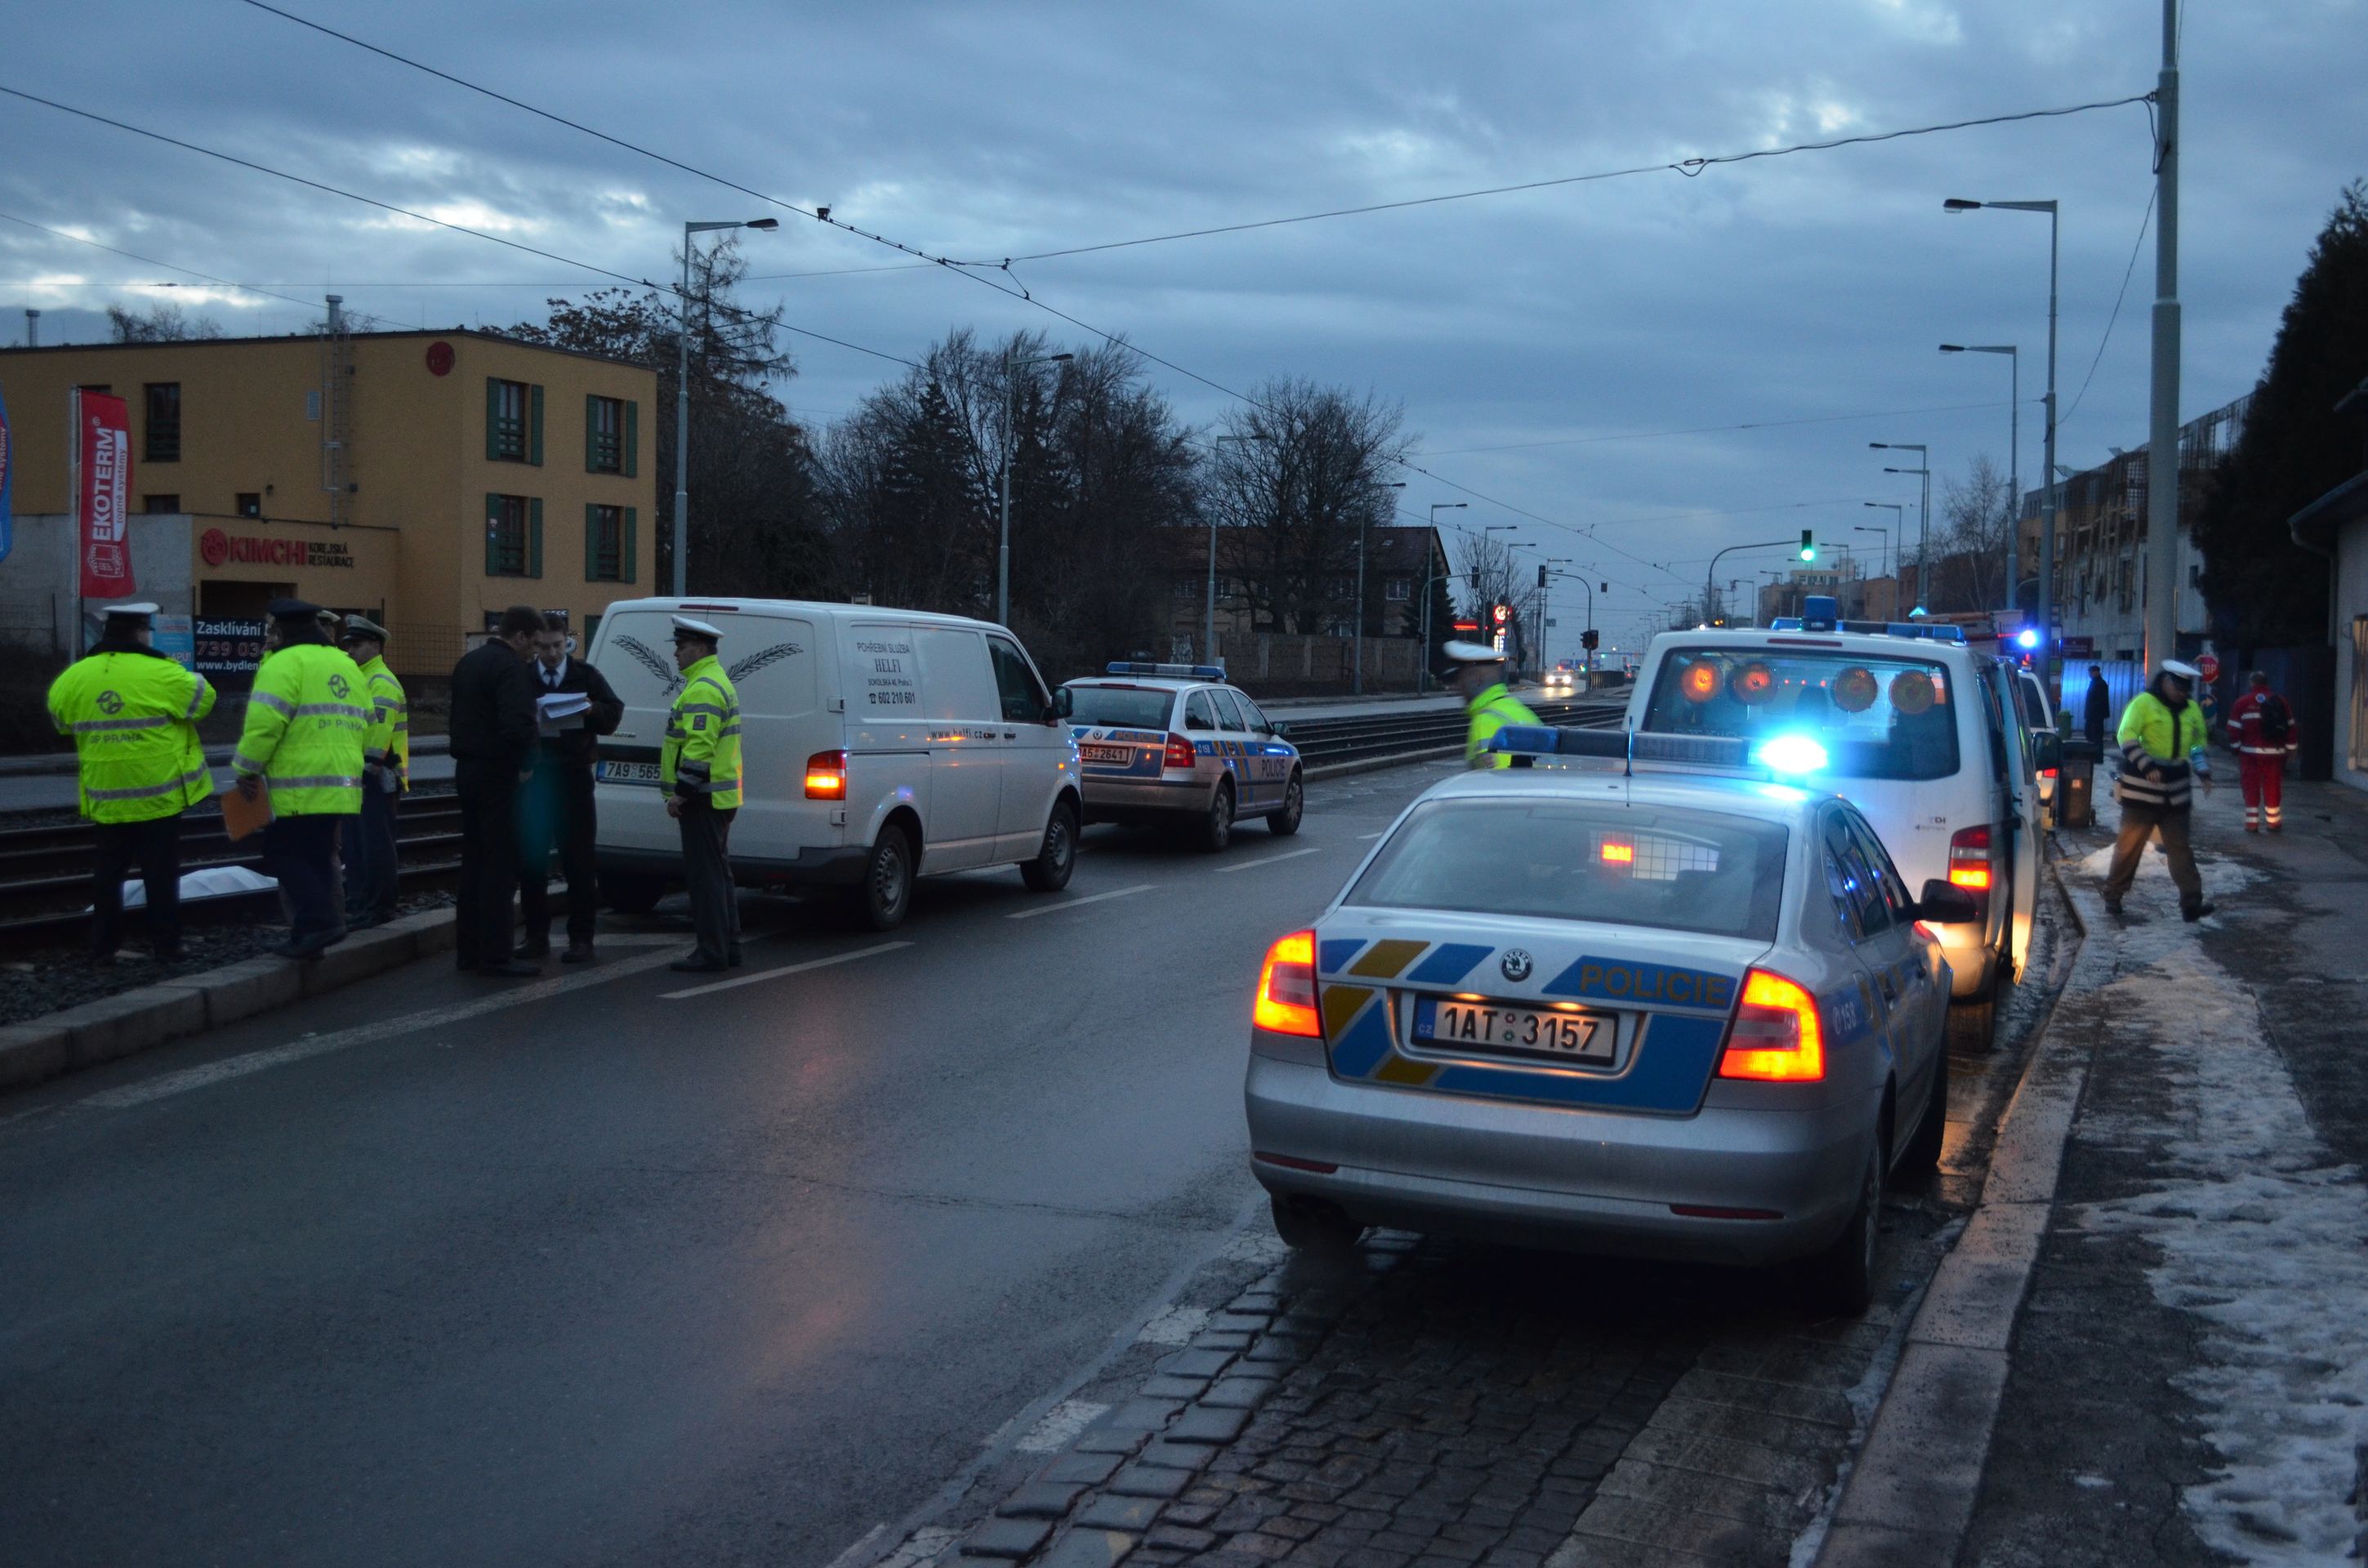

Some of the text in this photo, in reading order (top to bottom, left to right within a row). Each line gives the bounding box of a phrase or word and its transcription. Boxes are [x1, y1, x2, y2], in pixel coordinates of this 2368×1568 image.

[92, 428, 113, 541] EKOTERM
[229, 537, 308, 565] KIMCHI
[308, 541, 349, 555] KOREJSKÁ
[308, 555, 355, 568] RESTAURACE
[197, 621, 261, 636] Zasklívání
[197, 640, 232, 657] 739
[874, 658, 901, 673] HELFI
[878, 692, 916, 705] 602 210 601
[1116, 730, 1160, 743] POLICIE
[1099, 748, 1123, 761] 2641
[607, 762, 661, 779] 7A9 565
[1261, 758, 1285, 777] POLICIE
[1580, 964, 1727, 1006] POLICIE
[1841, 1000, 1857, 1032] 158
[1418, 1023, 1432, 1035] CZ
[1444, 1006, 1599, 1052] 1AT 3157
